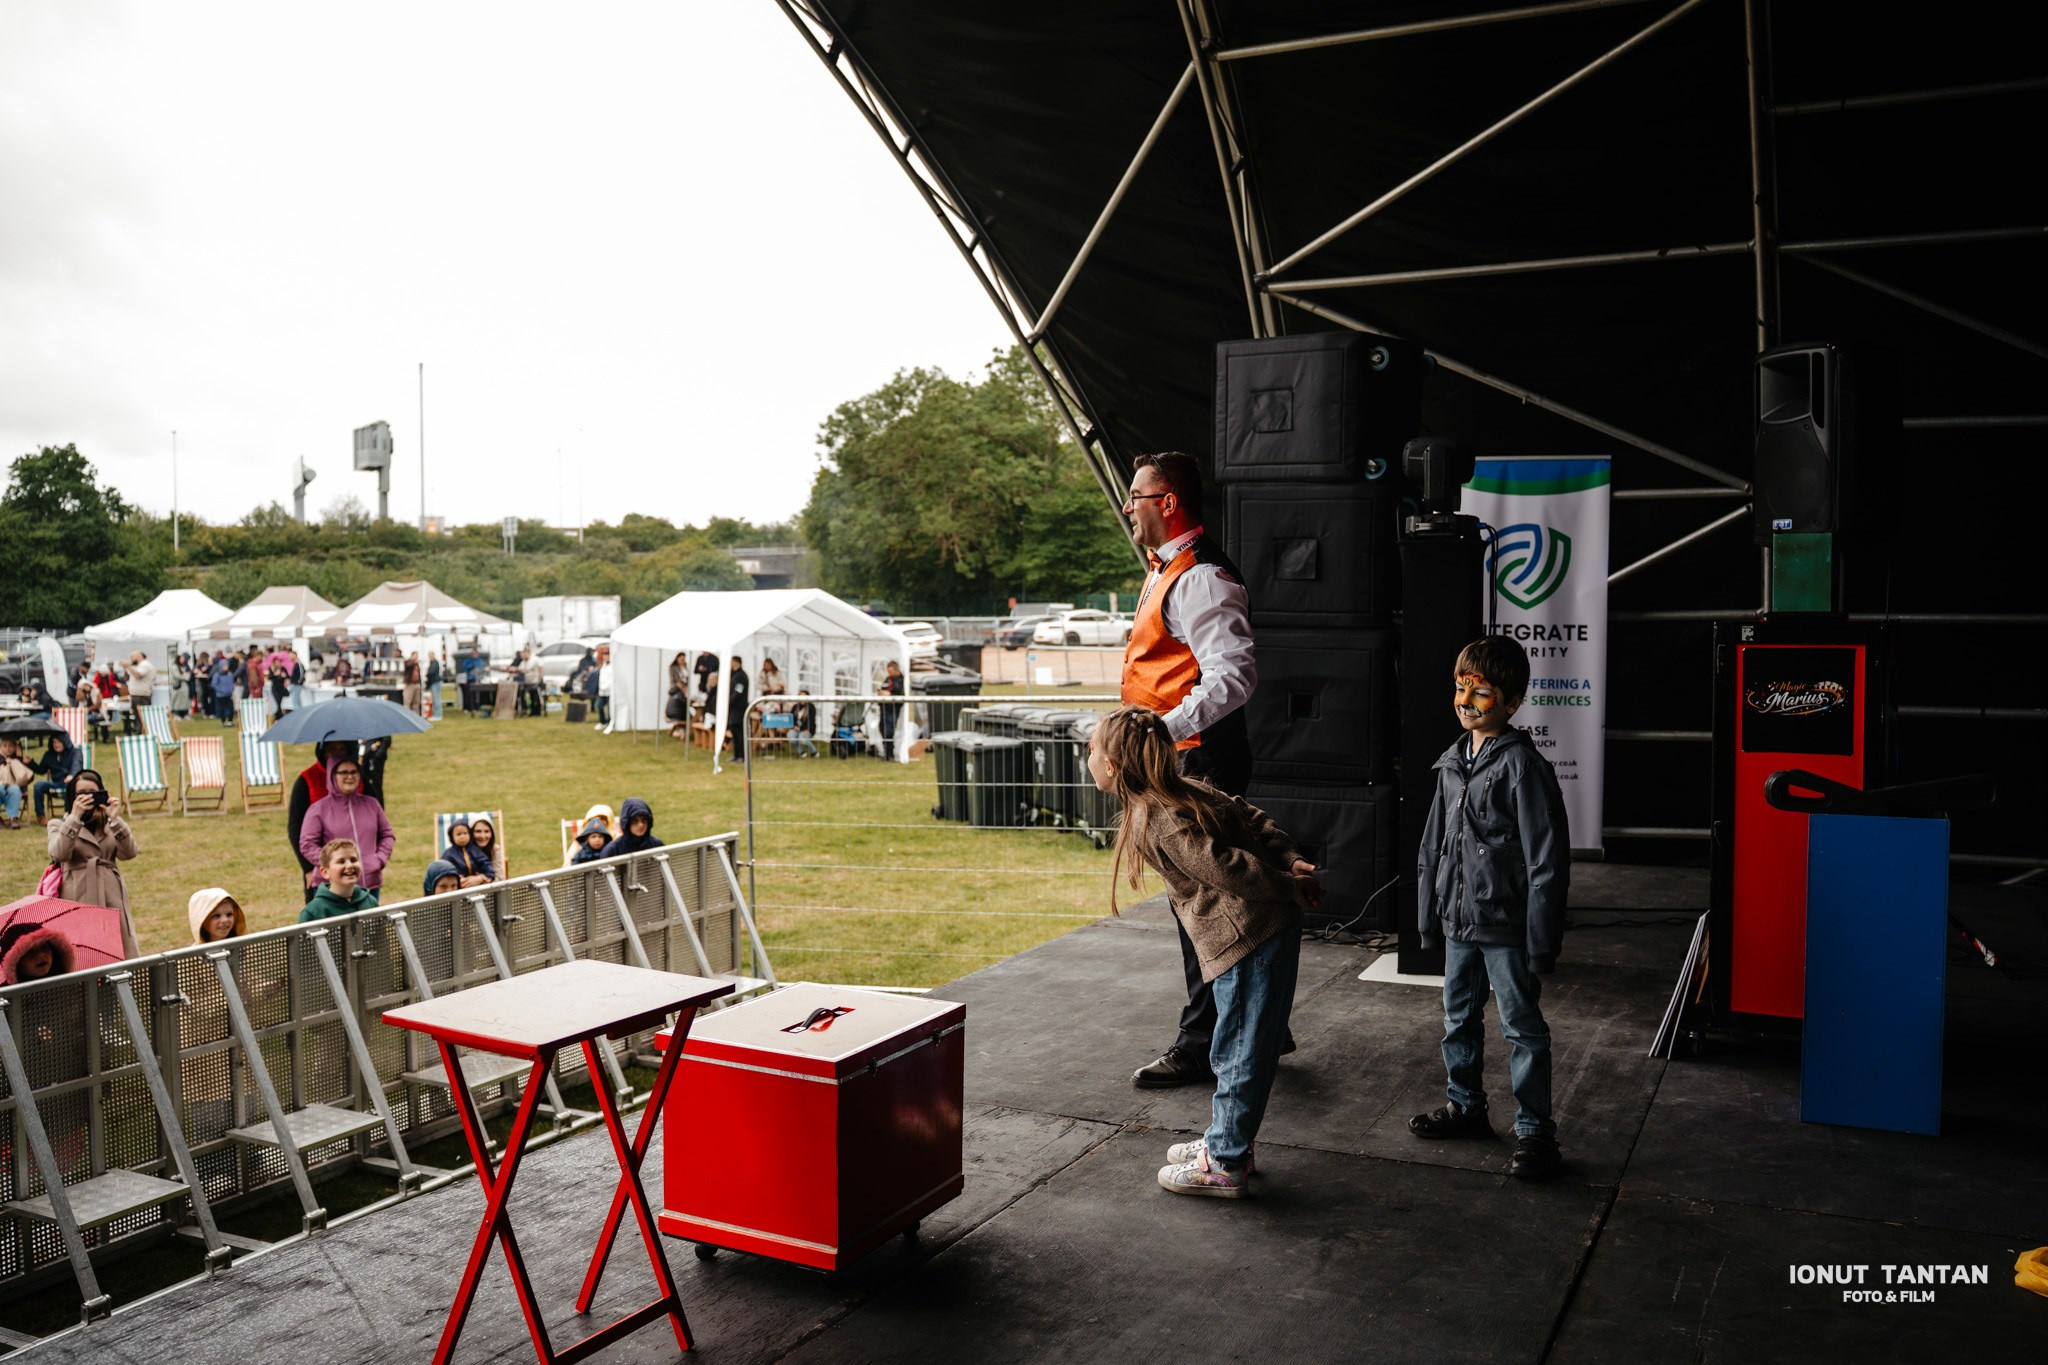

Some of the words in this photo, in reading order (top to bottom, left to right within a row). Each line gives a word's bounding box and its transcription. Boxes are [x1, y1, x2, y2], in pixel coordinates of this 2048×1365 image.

[1525, 647, 1568, 657] RITY
[1582, 679, 1591, 689] A
[1775, 681, 1806, 695] Magic
[1531, 696, 1591, 706] SERVICES
[1760, 691, 1829, 713] Marius
